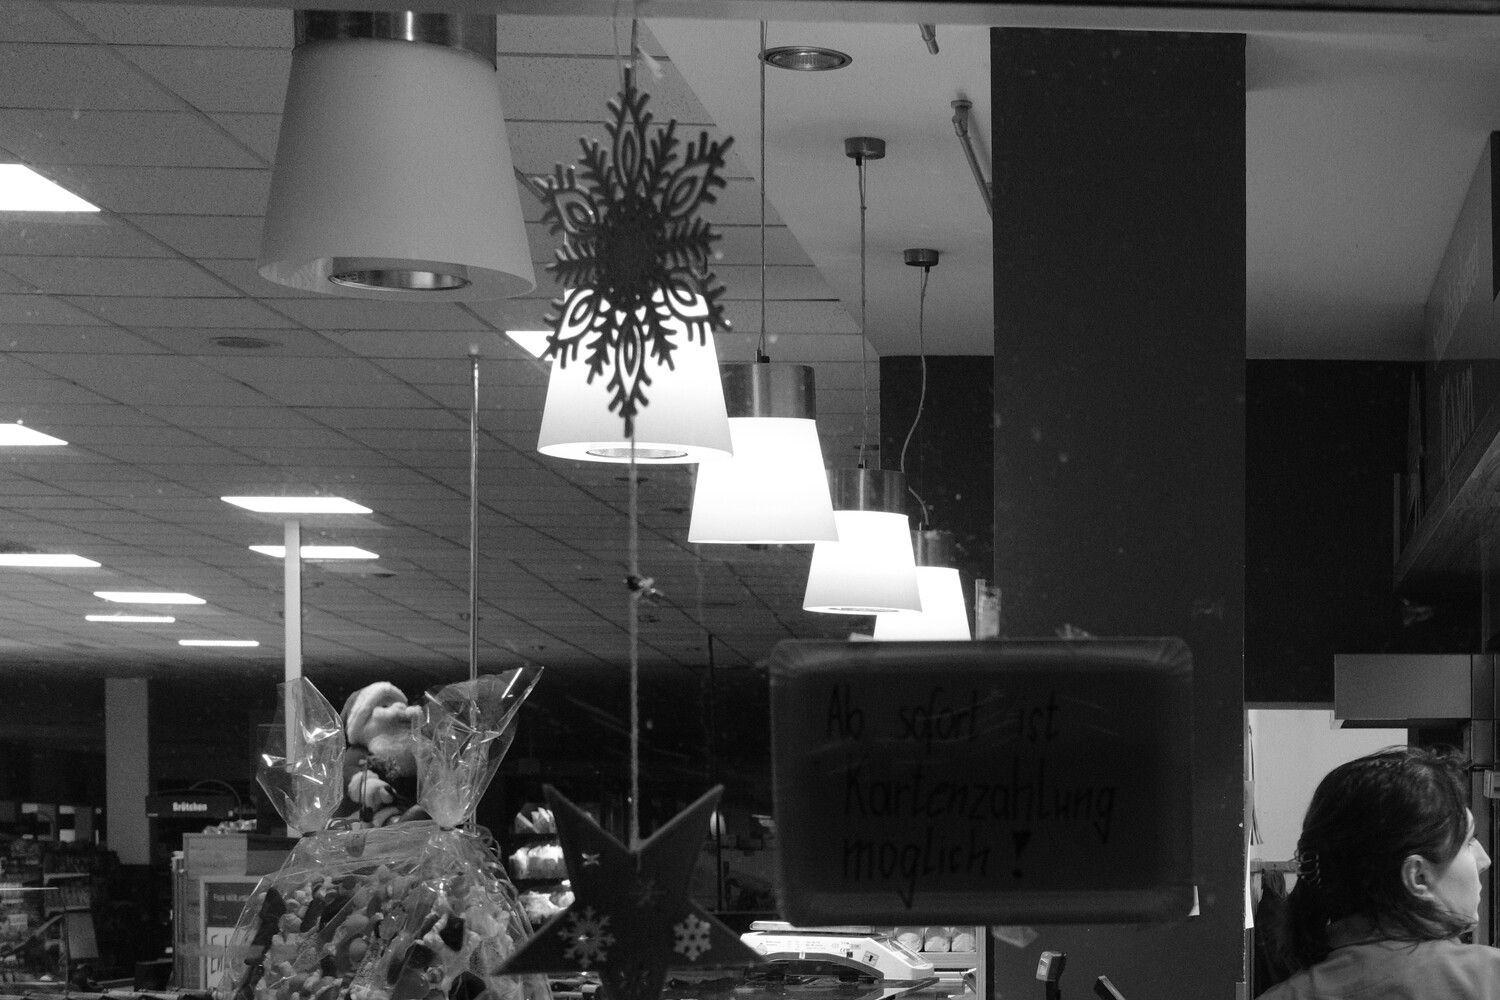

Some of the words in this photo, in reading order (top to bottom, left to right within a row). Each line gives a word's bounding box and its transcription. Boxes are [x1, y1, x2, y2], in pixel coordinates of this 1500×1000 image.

[825, 682, 865, 741] Ab
[897, 685, 984, 755] sofort
[1016, 688, 1061, 743] ist
[172, 801, 208, 812] Brötchen
[843, 756, 1116, 844] Kartenzahlung
